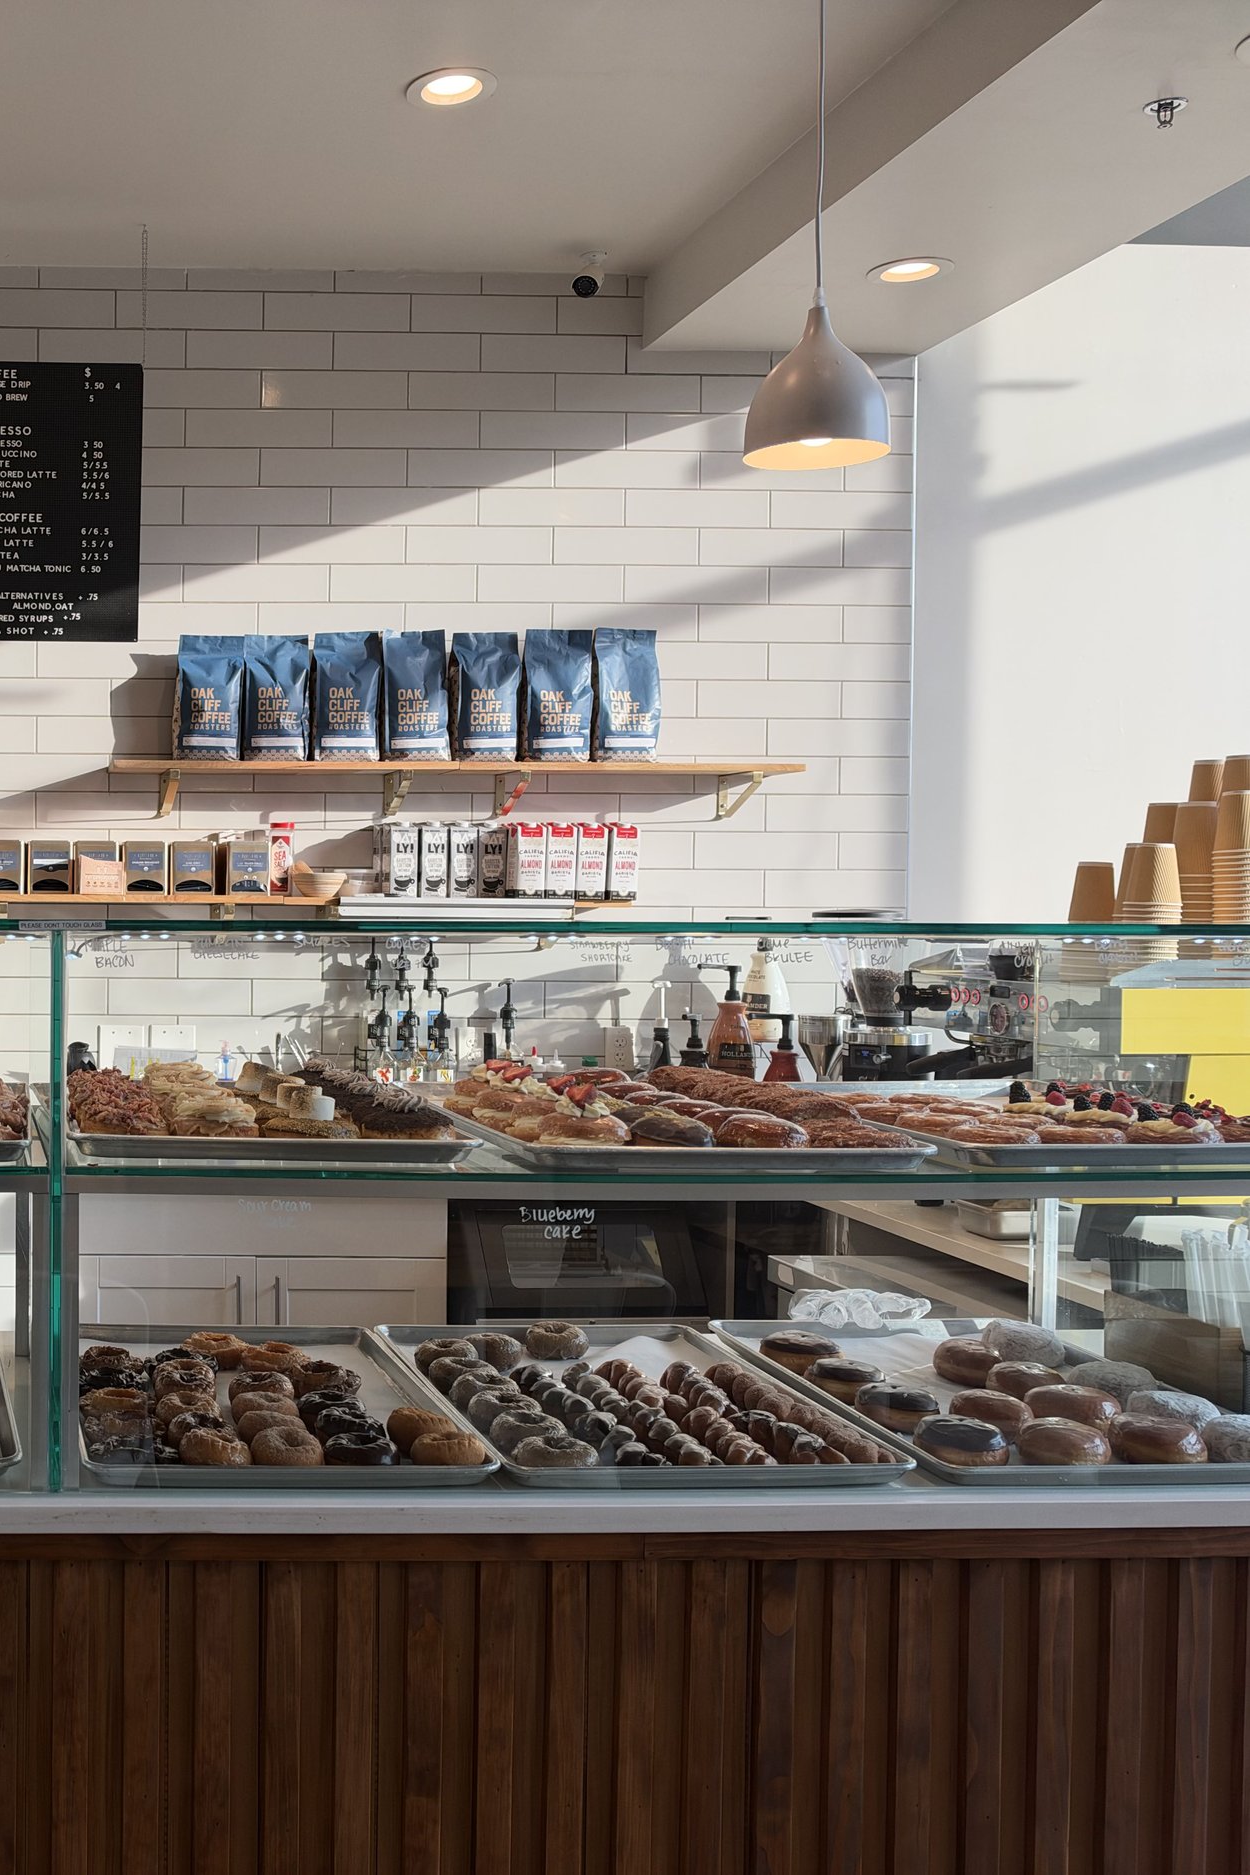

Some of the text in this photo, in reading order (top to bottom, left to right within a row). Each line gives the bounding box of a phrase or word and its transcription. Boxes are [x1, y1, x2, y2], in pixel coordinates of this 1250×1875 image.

[84, 366, 92, 378] $
[5, 393, 29, 402] BREW
[88, 394, 95, 403] 5
[21, 526, 52, 535] LATTE
[6, 564, 42, 573] MATCHA
[43, 564, 72, 573] TONIC
[80, 565, 102, 574] 6.50
[190, 687, 214, 699] OAK
[328, 687, 354, 698] OAK
[398, 688, 422, 700] OAK
[471, 688, 496, 700] OAK
[540, 690, 564, 701] OAK
[190, 700, 222, 712] CLIFF
[328, 700, 360, 711] CLIFF
[398, 700, 429, 712] CLIFF
[470, 700, 502, 712] CLIFF
[540, 702, 572, 712] CLIFF
[191, 712, 231, 724] COFFEE
[328, 712, 370, 724] COFFEE
[398, 712, 439, 724] COFFEE
[470, 713, 511, 724] COFFEE
[540, 714, 581, 726] COFFEE
[396, 843, 414, 853] LY!
[428, 843, 445, 853] LY!
[484, 844, 502, 854] LY!
[274, 850, 287, 860] SEA
[520, 860, 542, 869] ALMOND
[551, 860, 572, 869] ALMOND
[581, 861, 603, 870] ALMOND
[615, 861, 636, 870] ALMOND
[95, 955, 135, 968] BACON
[870, 954, 892, 965] Bar
[519, 1207, 595, 1224] Blueberry
